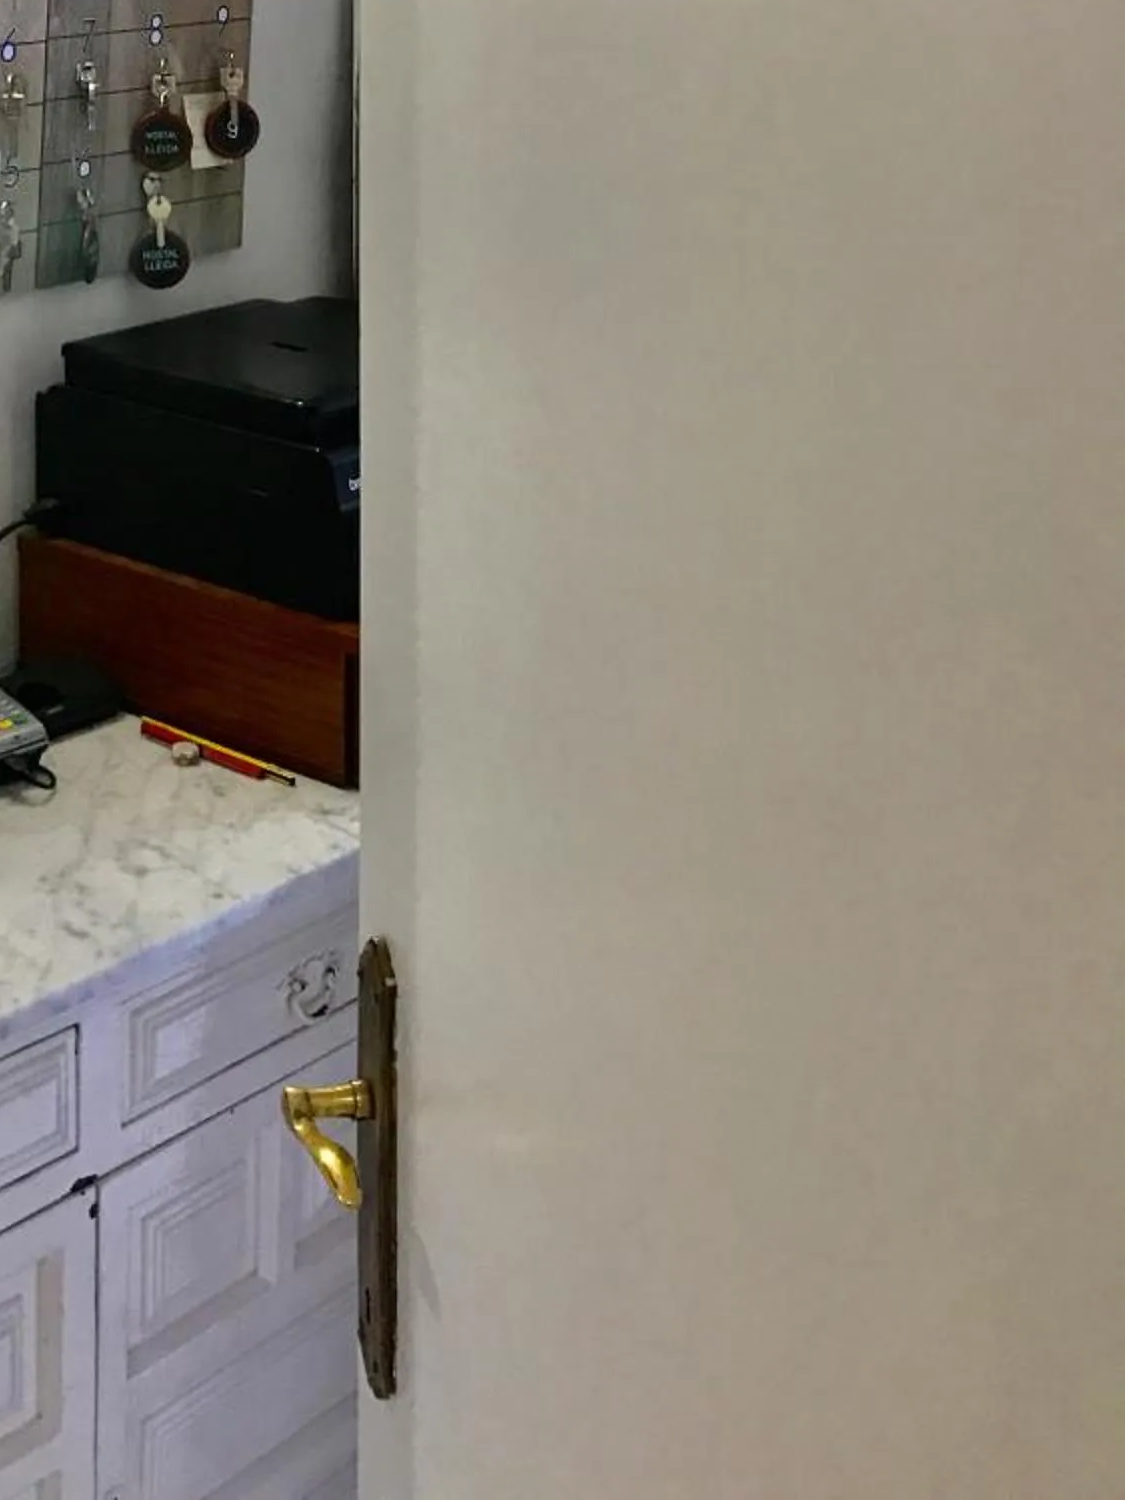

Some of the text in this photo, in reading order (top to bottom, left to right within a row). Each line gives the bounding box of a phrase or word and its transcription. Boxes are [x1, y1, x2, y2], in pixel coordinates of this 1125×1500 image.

[82, 18, 96, 53] 7
[148, 13, 164, 45] 8
[216, 4, 230, 36] 9
[0, 27, 17, 63] 6
